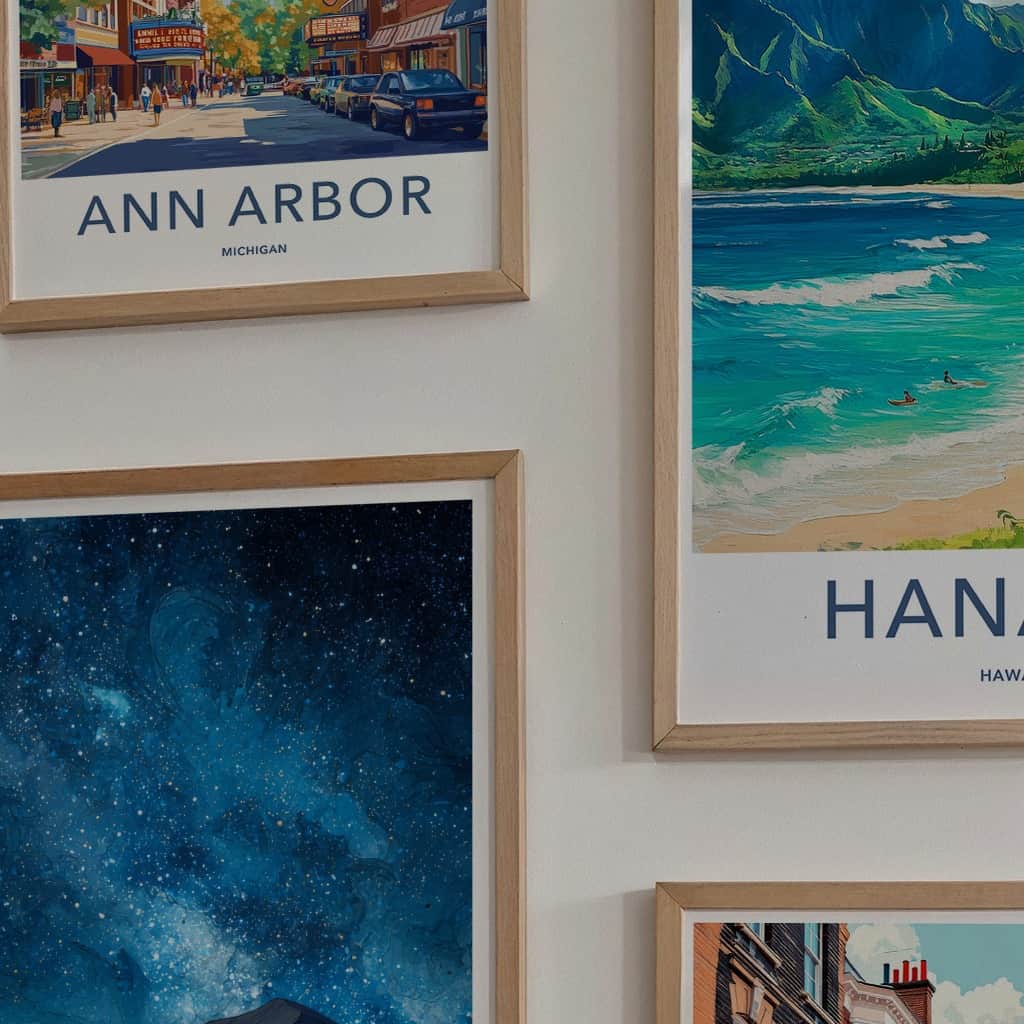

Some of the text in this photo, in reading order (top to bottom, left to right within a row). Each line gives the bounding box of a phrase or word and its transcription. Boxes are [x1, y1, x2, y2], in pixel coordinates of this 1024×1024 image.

[77, 175, 432, 236] ANN ARBOR
[221, 243, 288, 257] MICHIGAN
[826, 577, 1024, 639] HAN
[980, 668, 1024, 682] HAW
